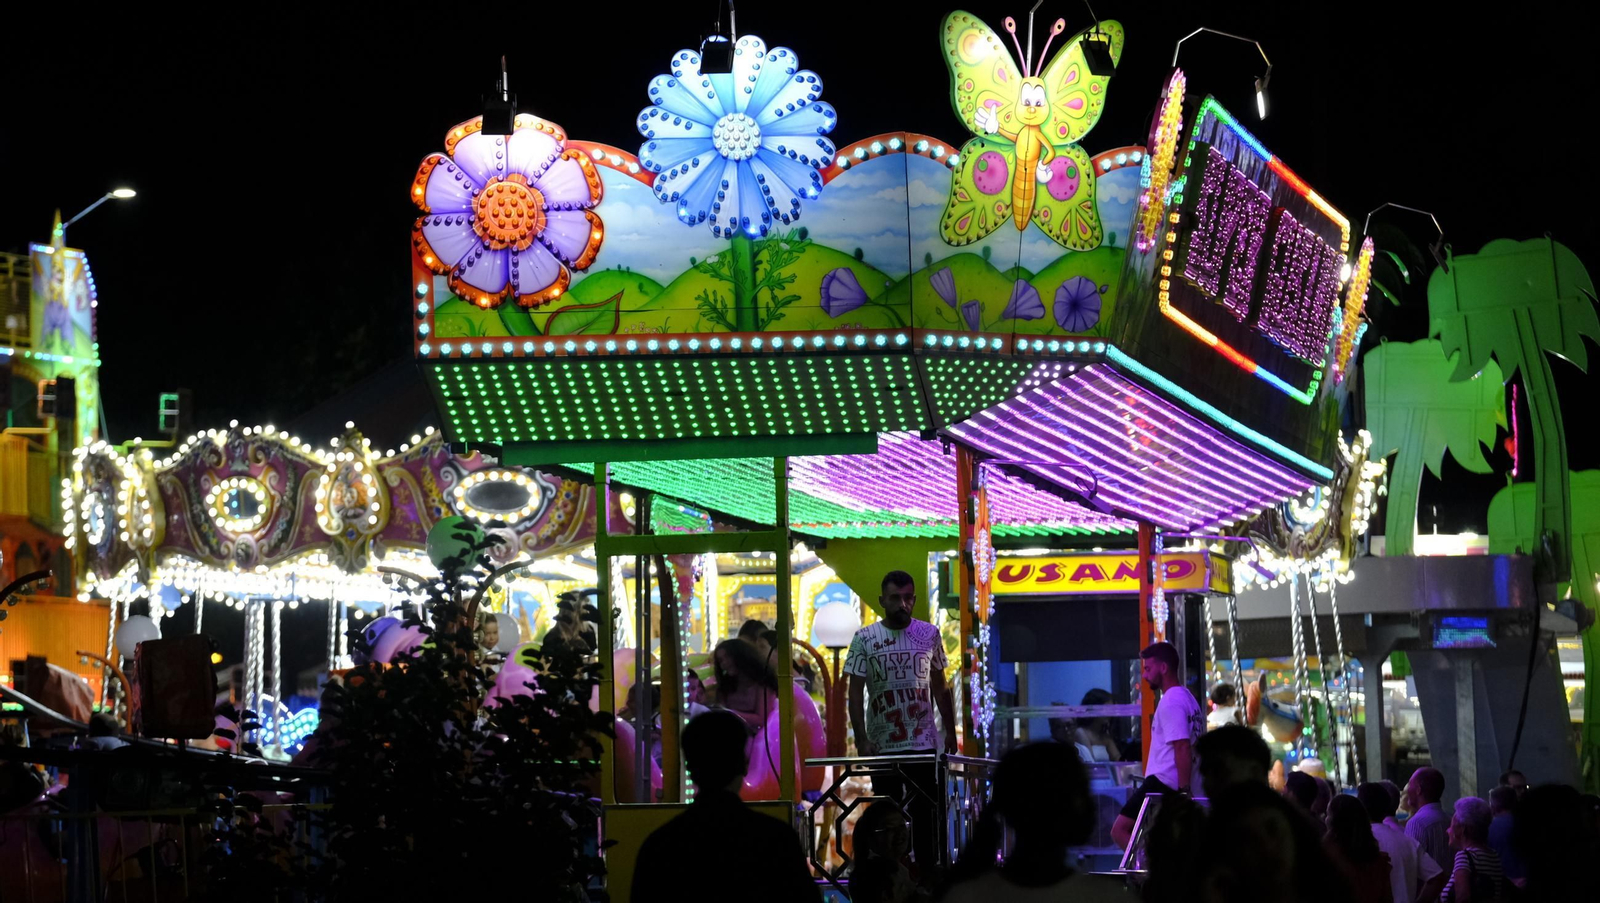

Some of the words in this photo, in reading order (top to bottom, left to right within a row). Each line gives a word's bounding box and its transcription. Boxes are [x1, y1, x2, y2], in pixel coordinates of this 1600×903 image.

[995, 559, 1196, 585] USANO
[869, 652, 931, 683] NYC
[871, 690, 895, 717] NEW
[897, 688, 928, 703] YORK
